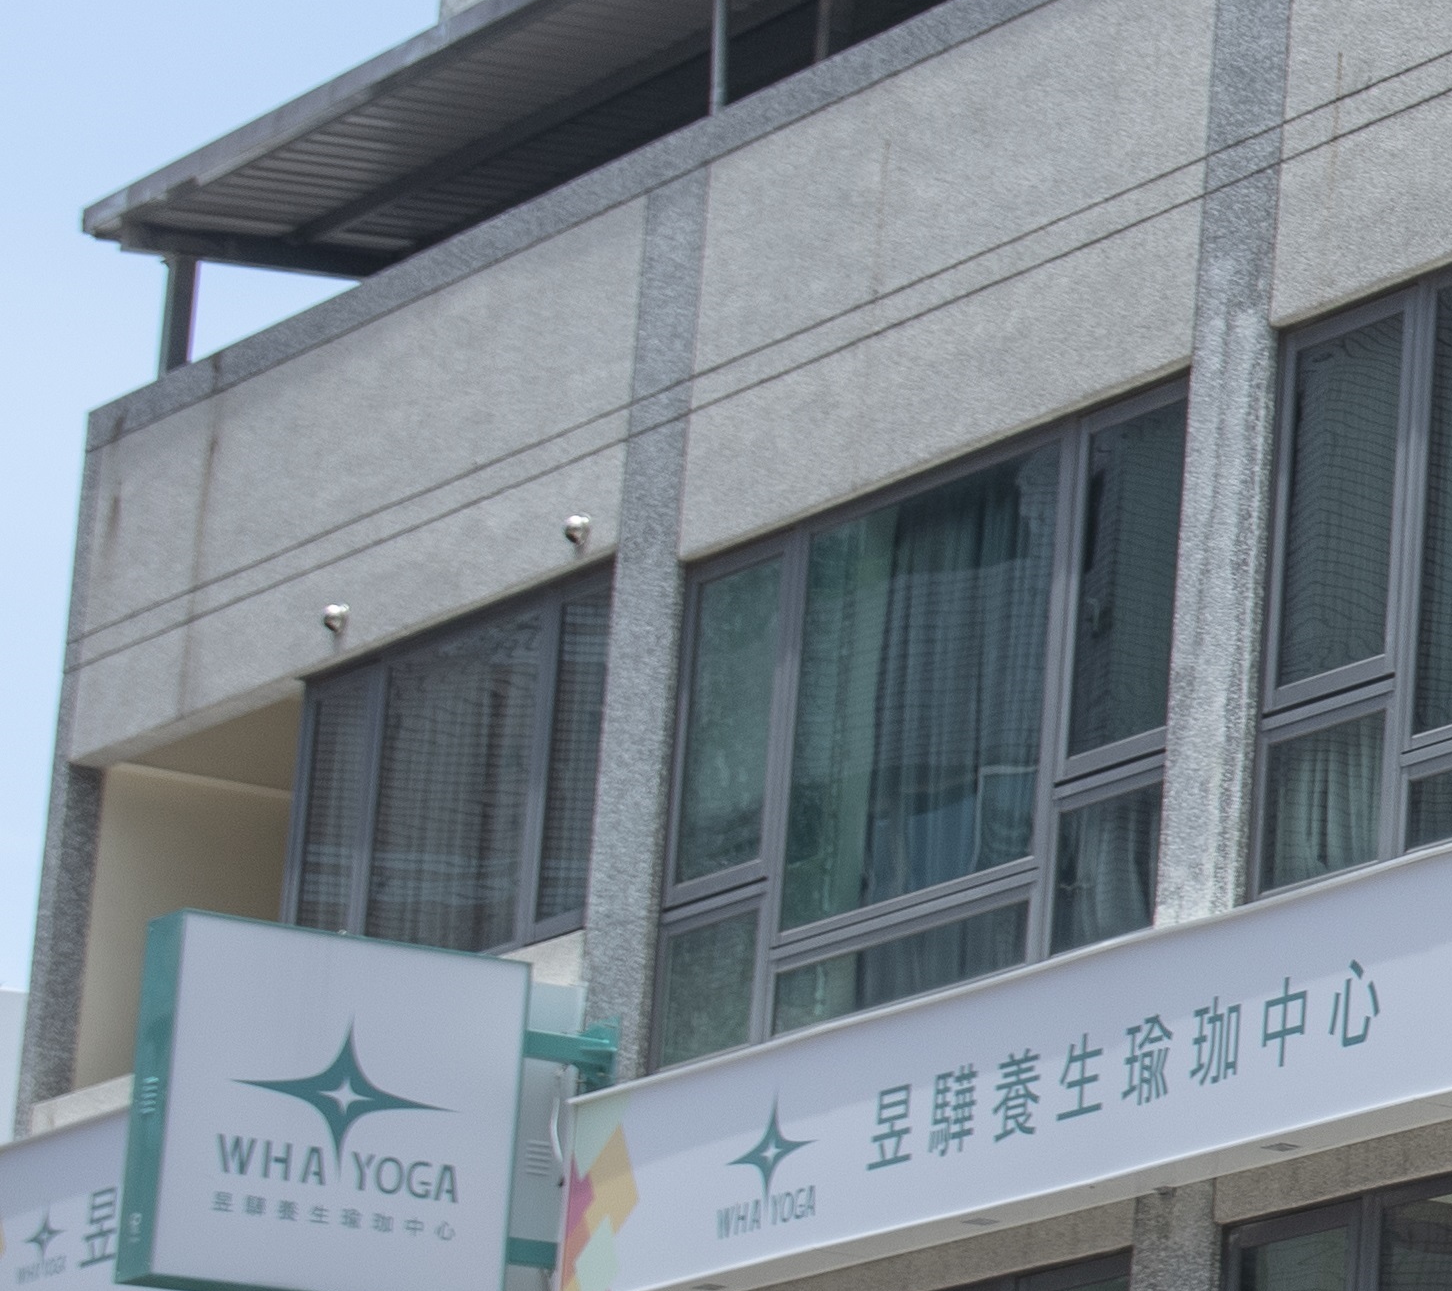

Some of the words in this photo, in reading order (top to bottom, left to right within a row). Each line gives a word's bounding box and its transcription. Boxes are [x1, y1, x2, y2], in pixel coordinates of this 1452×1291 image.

[866, 959, 1381, 1172] 昱驊養生瑜珈中心
[216, 1133, 326, 1186] WHA
[351, 1151, 459, 1203] YOGA
[716, 1199, 761, 1240] WHA
[771, 1185, 816, 1226] YOGA
